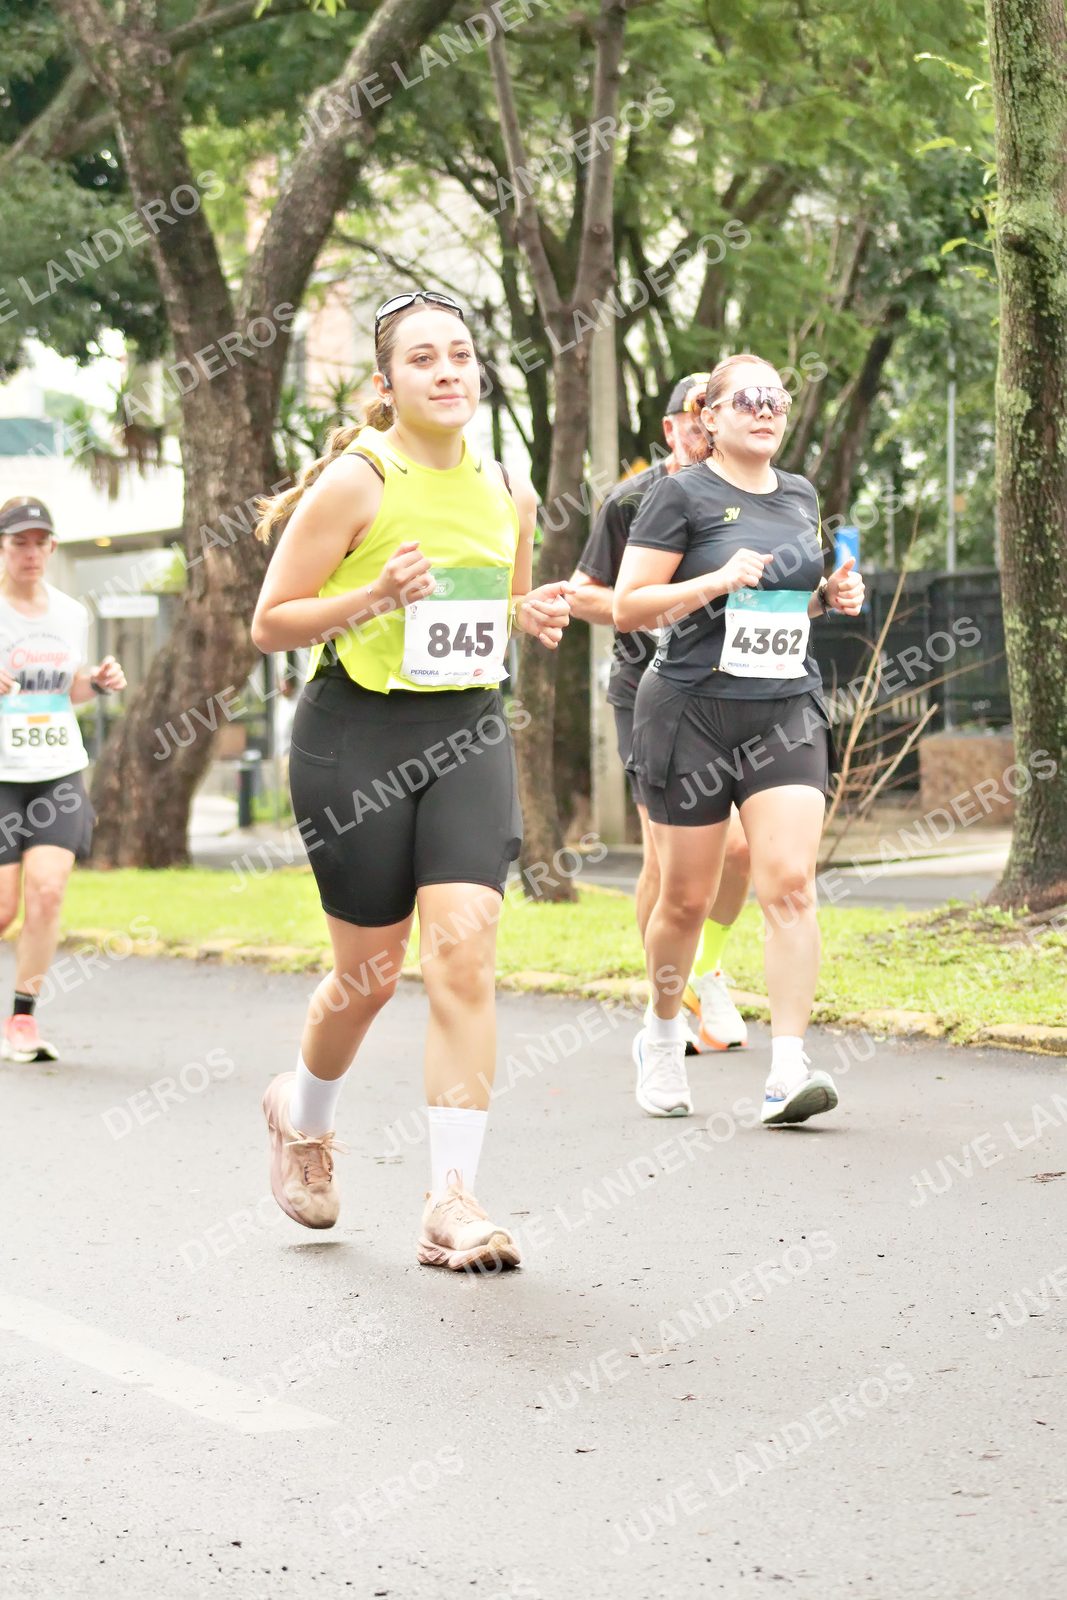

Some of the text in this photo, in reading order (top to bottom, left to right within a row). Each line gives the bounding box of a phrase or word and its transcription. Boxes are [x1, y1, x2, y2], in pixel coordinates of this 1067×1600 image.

[428, 622, 494, 658] 845
[731, 627, 803, 655] 4362
[11, 727, 69, 746] 5868
